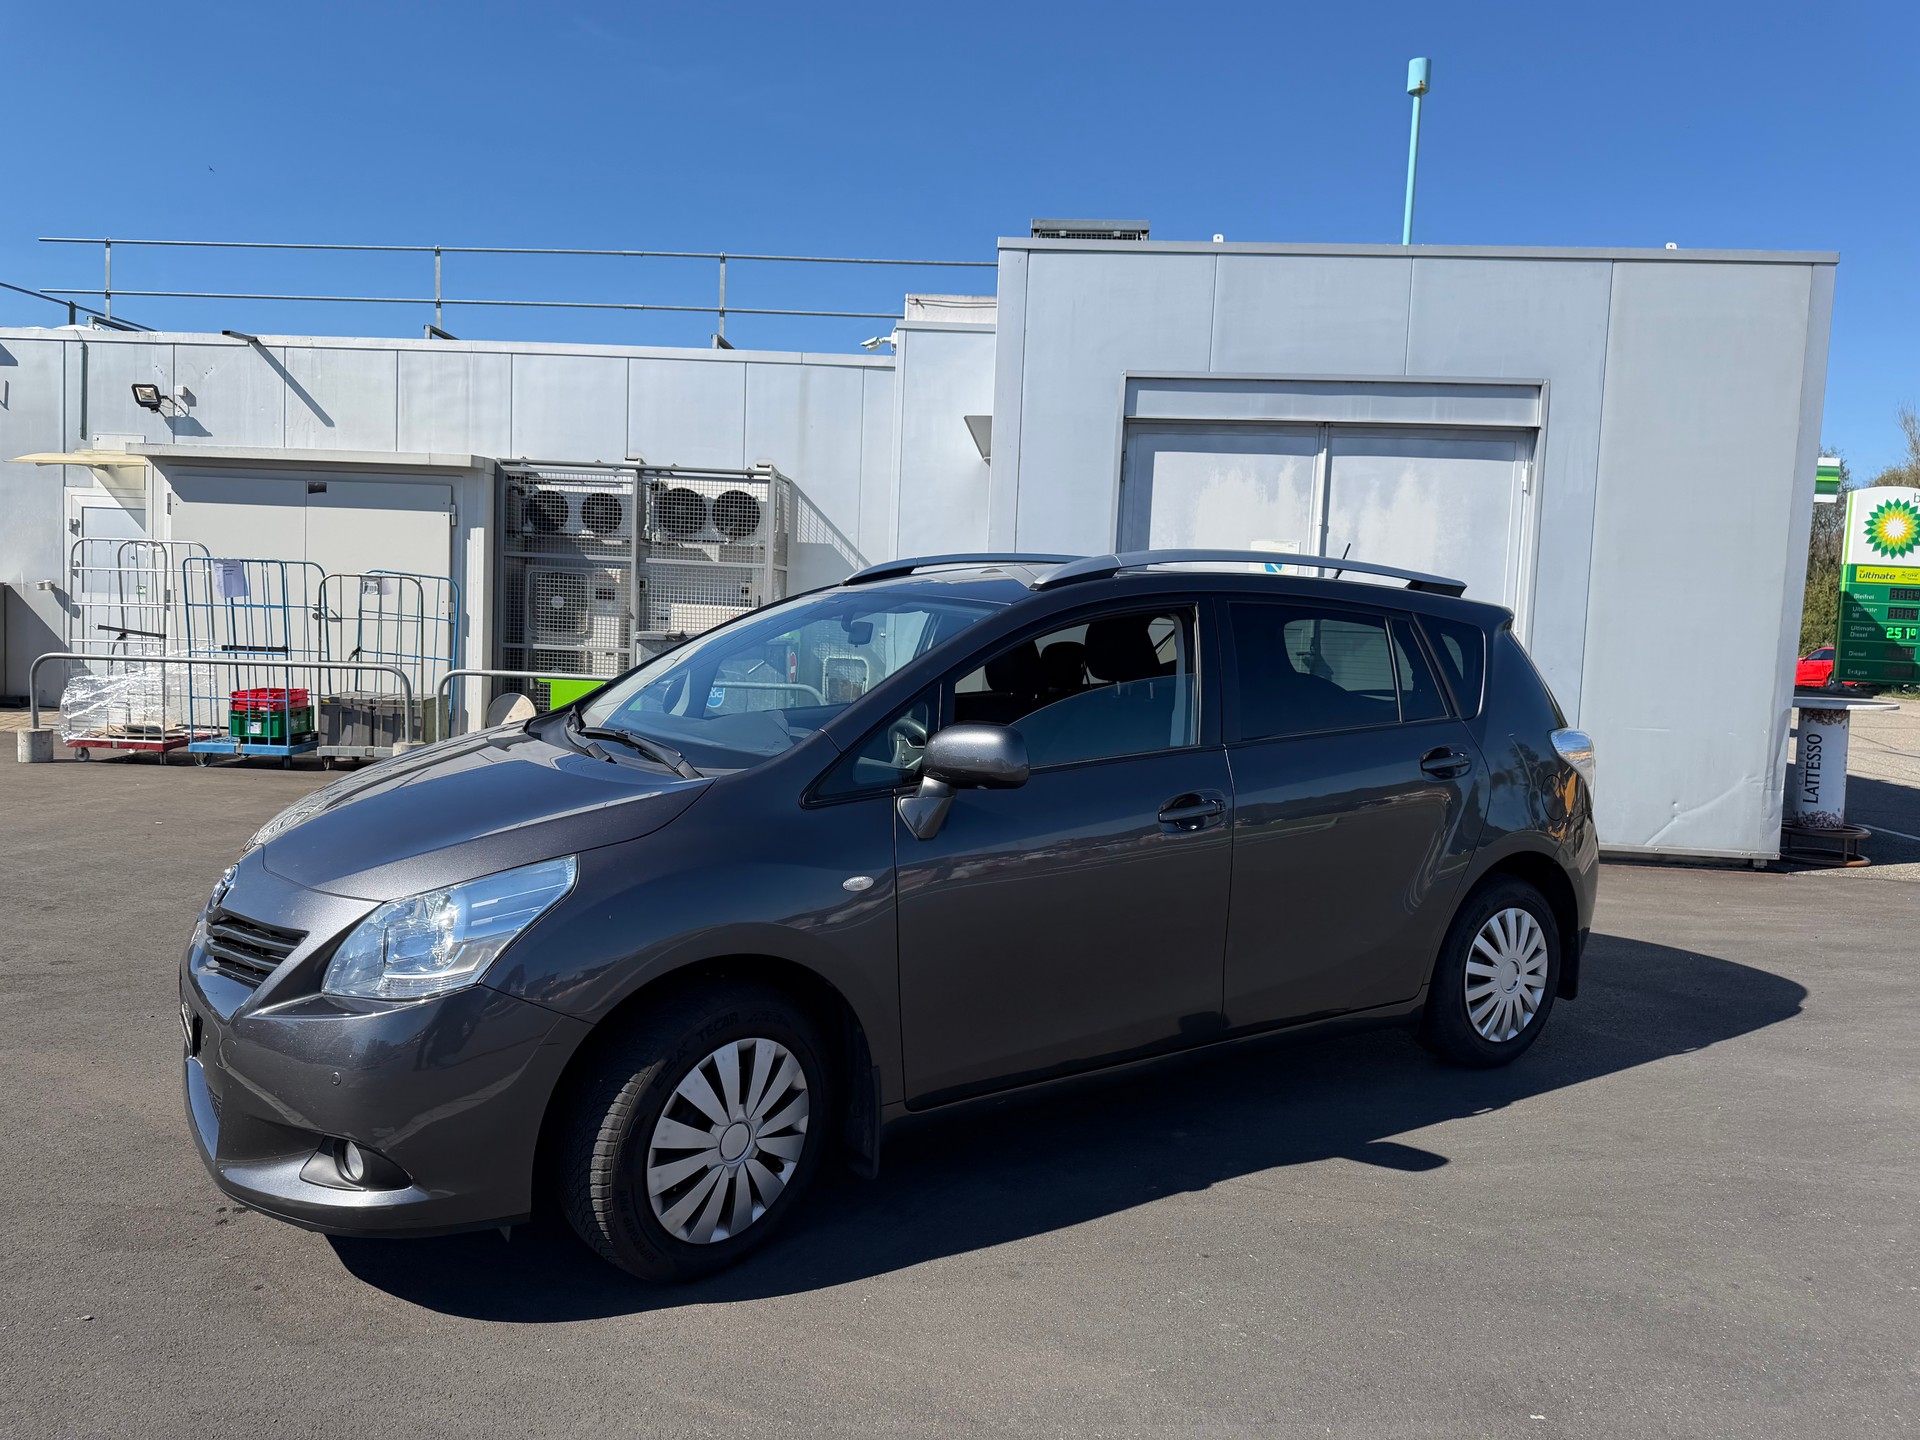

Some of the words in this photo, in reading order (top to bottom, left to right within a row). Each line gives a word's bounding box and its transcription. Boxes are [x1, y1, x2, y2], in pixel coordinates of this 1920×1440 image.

[1859, 572, 1896, 580] ultimate
[1803, 733, 1823, 804] LATTESSO
[696, 1012, 739, 1042] TECAR
